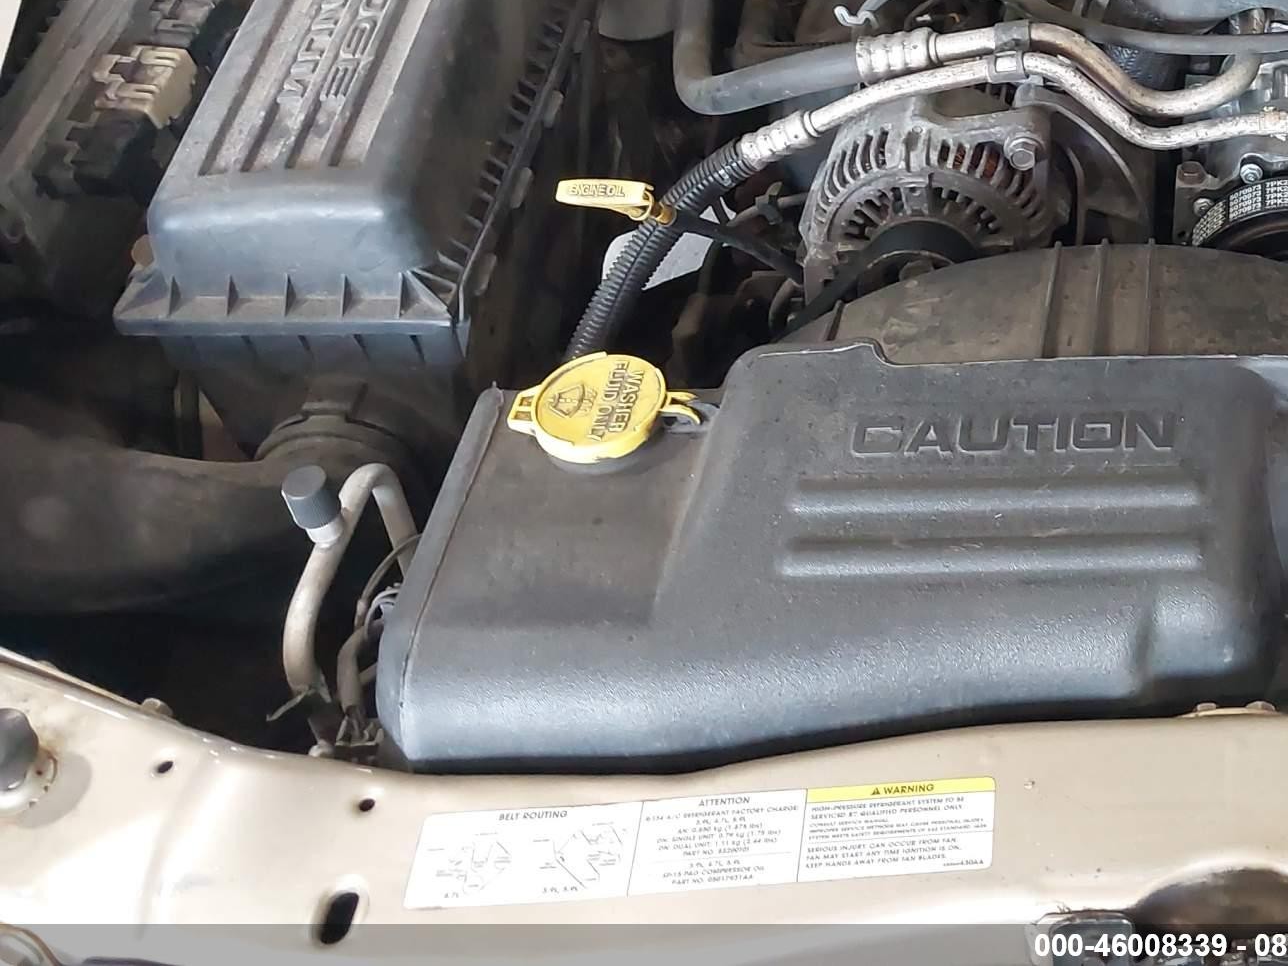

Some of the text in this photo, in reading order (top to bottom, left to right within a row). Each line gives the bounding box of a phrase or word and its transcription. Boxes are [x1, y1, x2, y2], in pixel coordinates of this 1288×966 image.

[569, 184, 625, 198] ENGINE OIL
[587, 361, 630, 442] FLUID ONLY
[608, 369, 645, 434] WASHER
[851, 414, 1176, 458] CAUTION
[884, 783, 935, 795] WARNING
[698, 796, 751, 807] ATTENTION
[498, 810, 568, 821] BELT ROUTING
[732, 807, 764, 815] FACTORY
[807, 845, 837, 853] SERIOUS
[840, 843, 865, 851] INJURY
[902, 845, 937, 854] IGNITION
